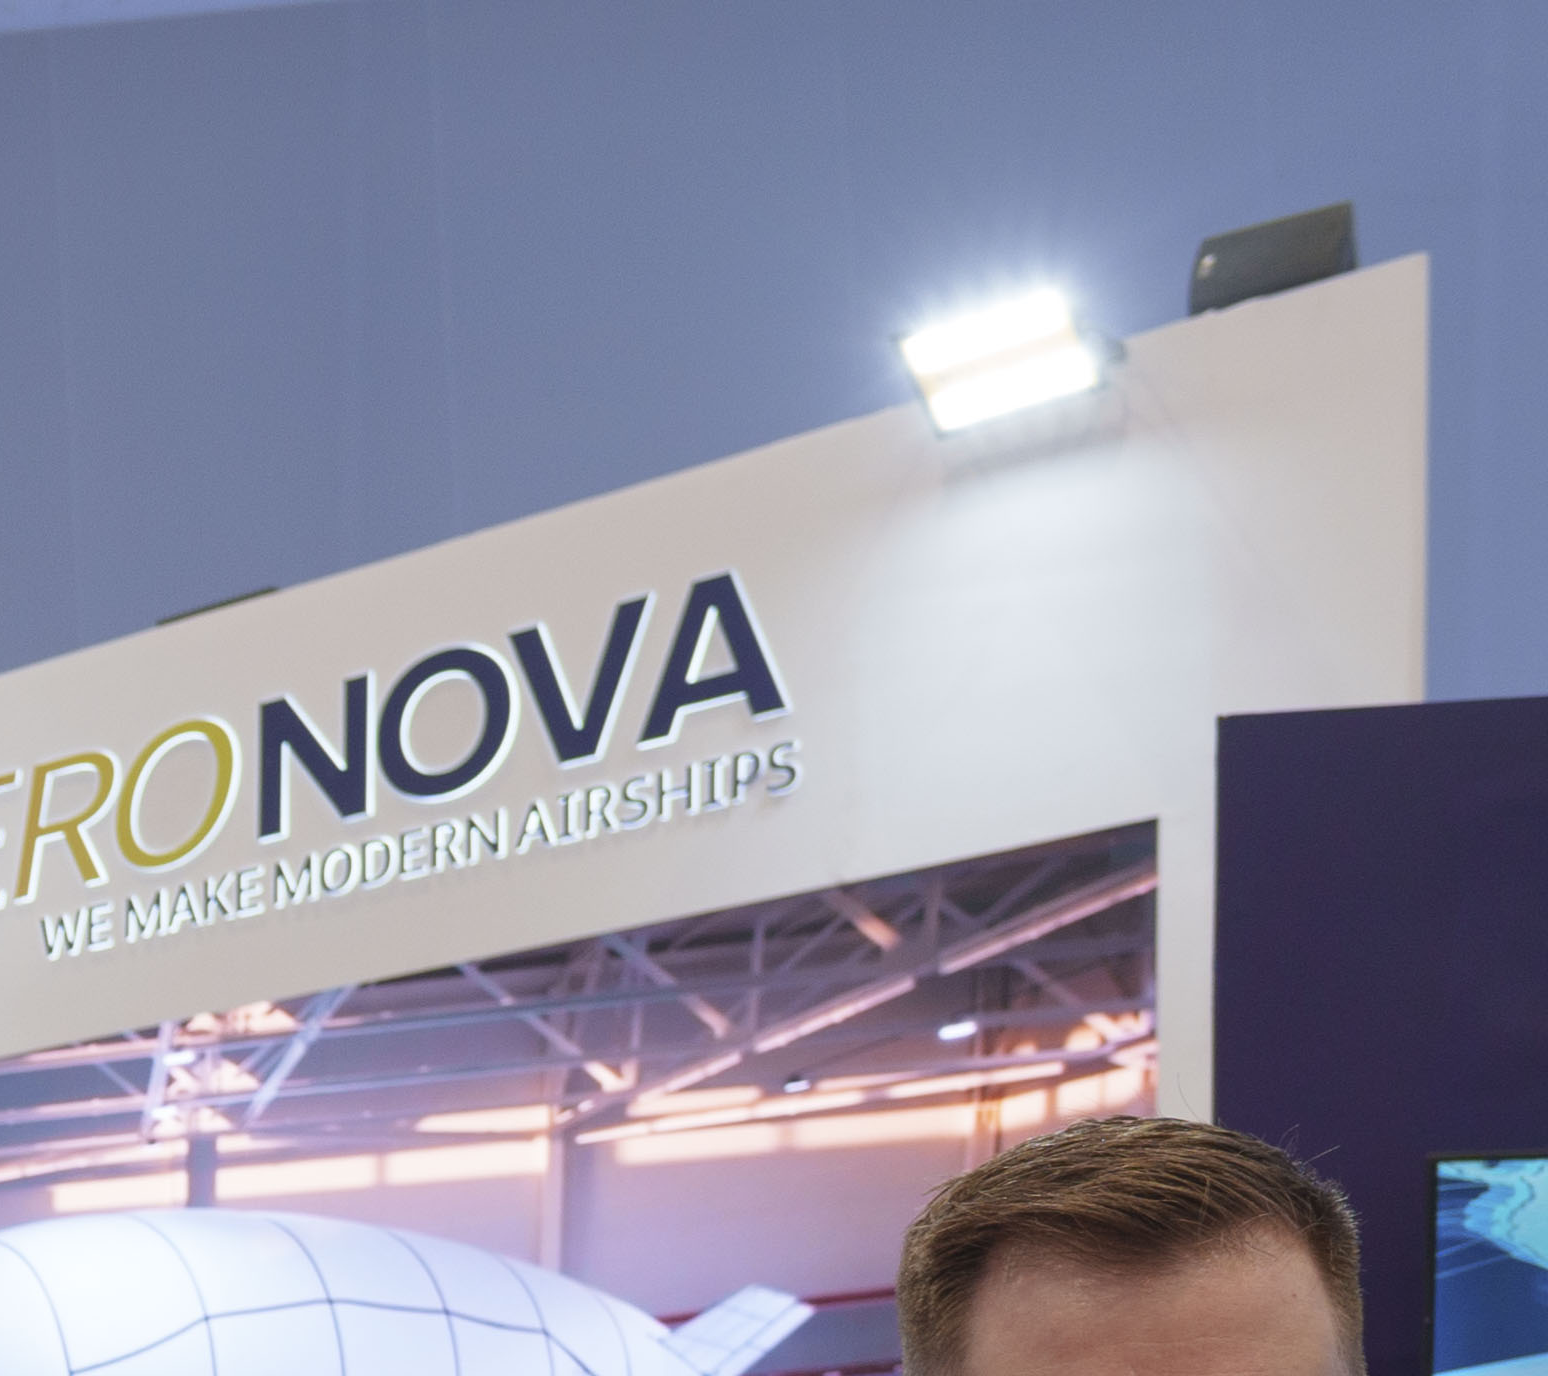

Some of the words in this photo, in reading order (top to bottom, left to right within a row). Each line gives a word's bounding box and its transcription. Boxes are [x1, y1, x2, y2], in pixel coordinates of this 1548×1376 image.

[41, 901, 116, 961] WE
[125, 865, 266, 945] MAKE
[274, 807, 510, 910] MODERN
[517, 741, 800, 856] AIRSHIPS
